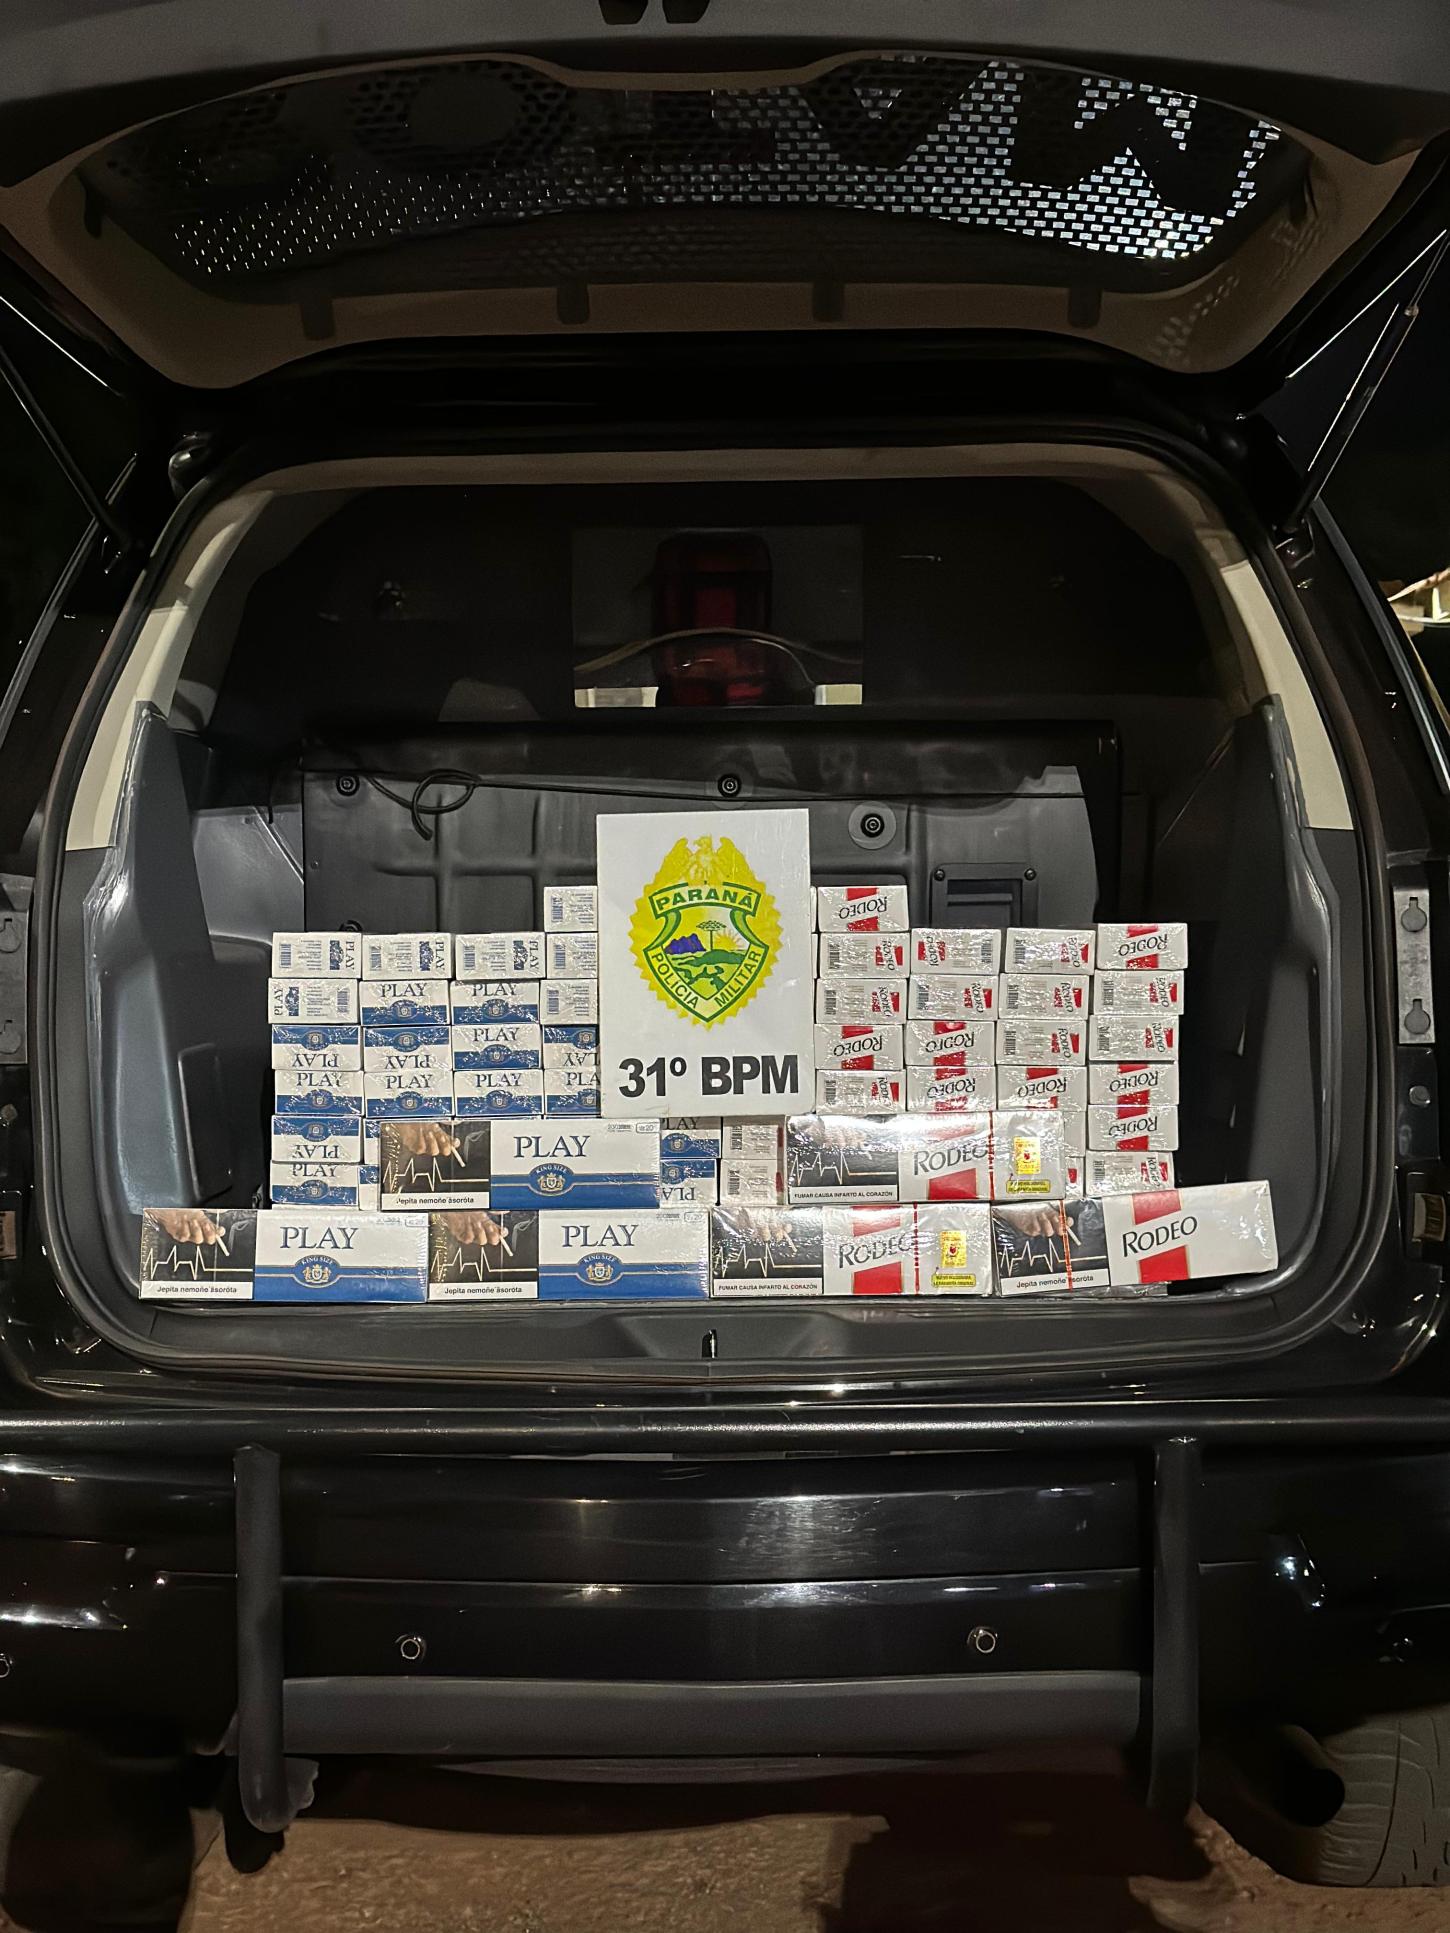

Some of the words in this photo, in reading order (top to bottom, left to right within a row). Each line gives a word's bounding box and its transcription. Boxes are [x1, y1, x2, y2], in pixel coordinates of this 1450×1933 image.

[657, 888, 755, 913] PARANÁ
[838, 895, 888, 920] RODEO
[345, 940, 355, 971] PLAY
[1118, 932, 1168, 957] RODEO
[435, 941, 445, 972] PLAY
[381, 982, 428, 998] PLAY
[472, 982, 518, 997] PLAY
[651, 951, 699, 1009] POLÍCIA
[713, 950, 762, 1008] MILITAR
[273, 985, 283, 1017] PLAY
[473, 1027, 519, 1042] PLAY
[833, 1034, 882, 1057] RODEO
[292, 1053, 338, 1068] PLAY
[384, 1054, 431, 1069] PLAY
[564, 1052, 600, 1067] LAY
[297, 1072, 342, 1087] PLAY
[386, 1074, 432, 1089] PLAY
[476, 1073, 522, 1088] PLAY
[565, 1072, 600, 1087] PLA
[701, 1054, 799, 1096] BPM
[1017, 1075, 1067, 1098] RODEO
[1109, 1070, 1159, 1093] RODEO
[926, 1076, 976, 1099] RODEO
[294, 1145, 338, 1159] PLAY
[513, 1135, 590, 1158] PLAY
[292, 1163, 337, 1177] PLAY
[662, 1187, 695, 1200] PLA
[280, 1226, 359, 1250] PLAY
[561, 1224, 639, 1248] PLAY
[1122, 1216, 1198, 1258] RODEO
[1016, 1280, 1038, 1289] Jepita
